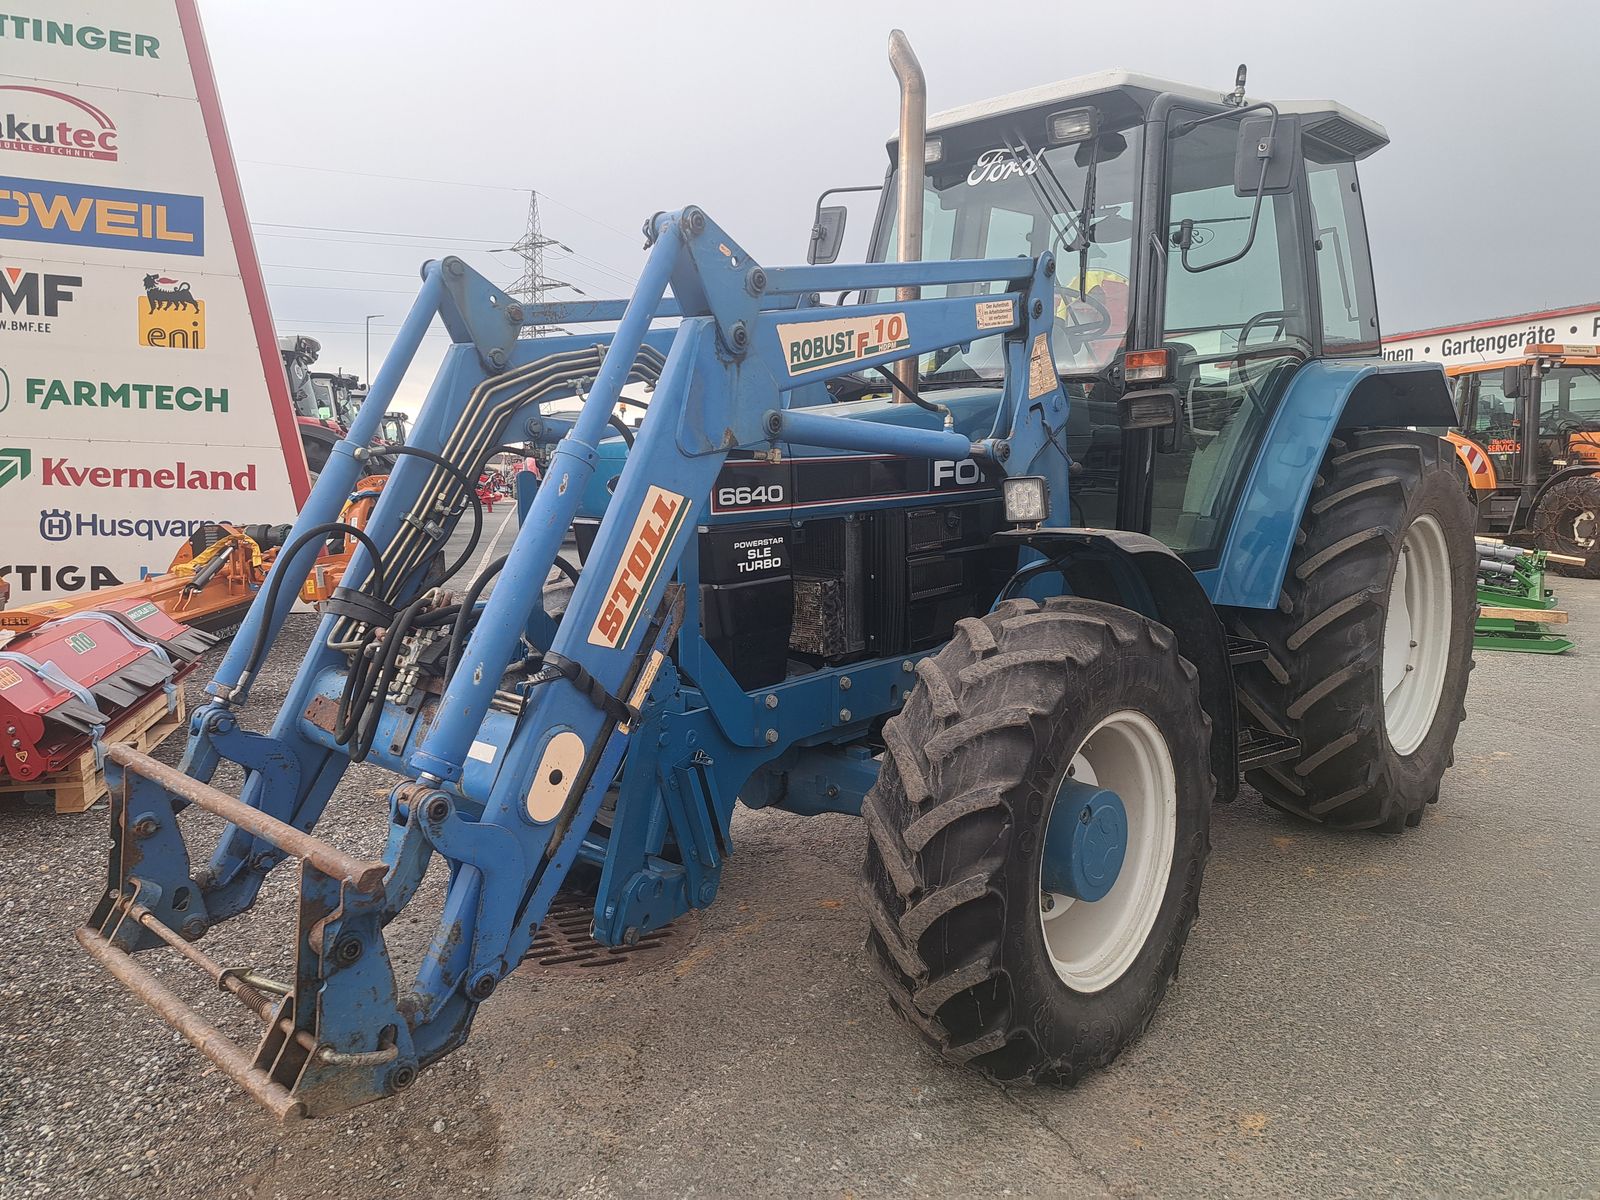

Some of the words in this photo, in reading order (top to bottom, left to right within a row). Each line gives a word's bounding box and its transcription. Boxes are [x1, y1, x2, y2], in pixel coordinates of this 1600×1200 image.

[0, 113, 118, 151] kutec
[967, 145, 1046, 186] Ford
[147, 321, 199, 349] eni
[790, 329, 855, 363] ROBUST
[857, 331, 869, 358] F
[875, 315, 902, 344] 10
[1441, 326, 1556, 357] Gartengeräte
[26, 378, 229, 413] FARMTECH
[41, 457, 257, 491] Kverneland
[934, 458, 986, 487] FO
[719, 484, 784, 506] 6640
[76, 513, 233, 541] Husqvar
[734, 536, 784, 550] POWERSTAR
[747, 547, 772, 560] SLE
[597, 494, 678, 644] STOLL
[737, 557, 782, 573] TURBO
